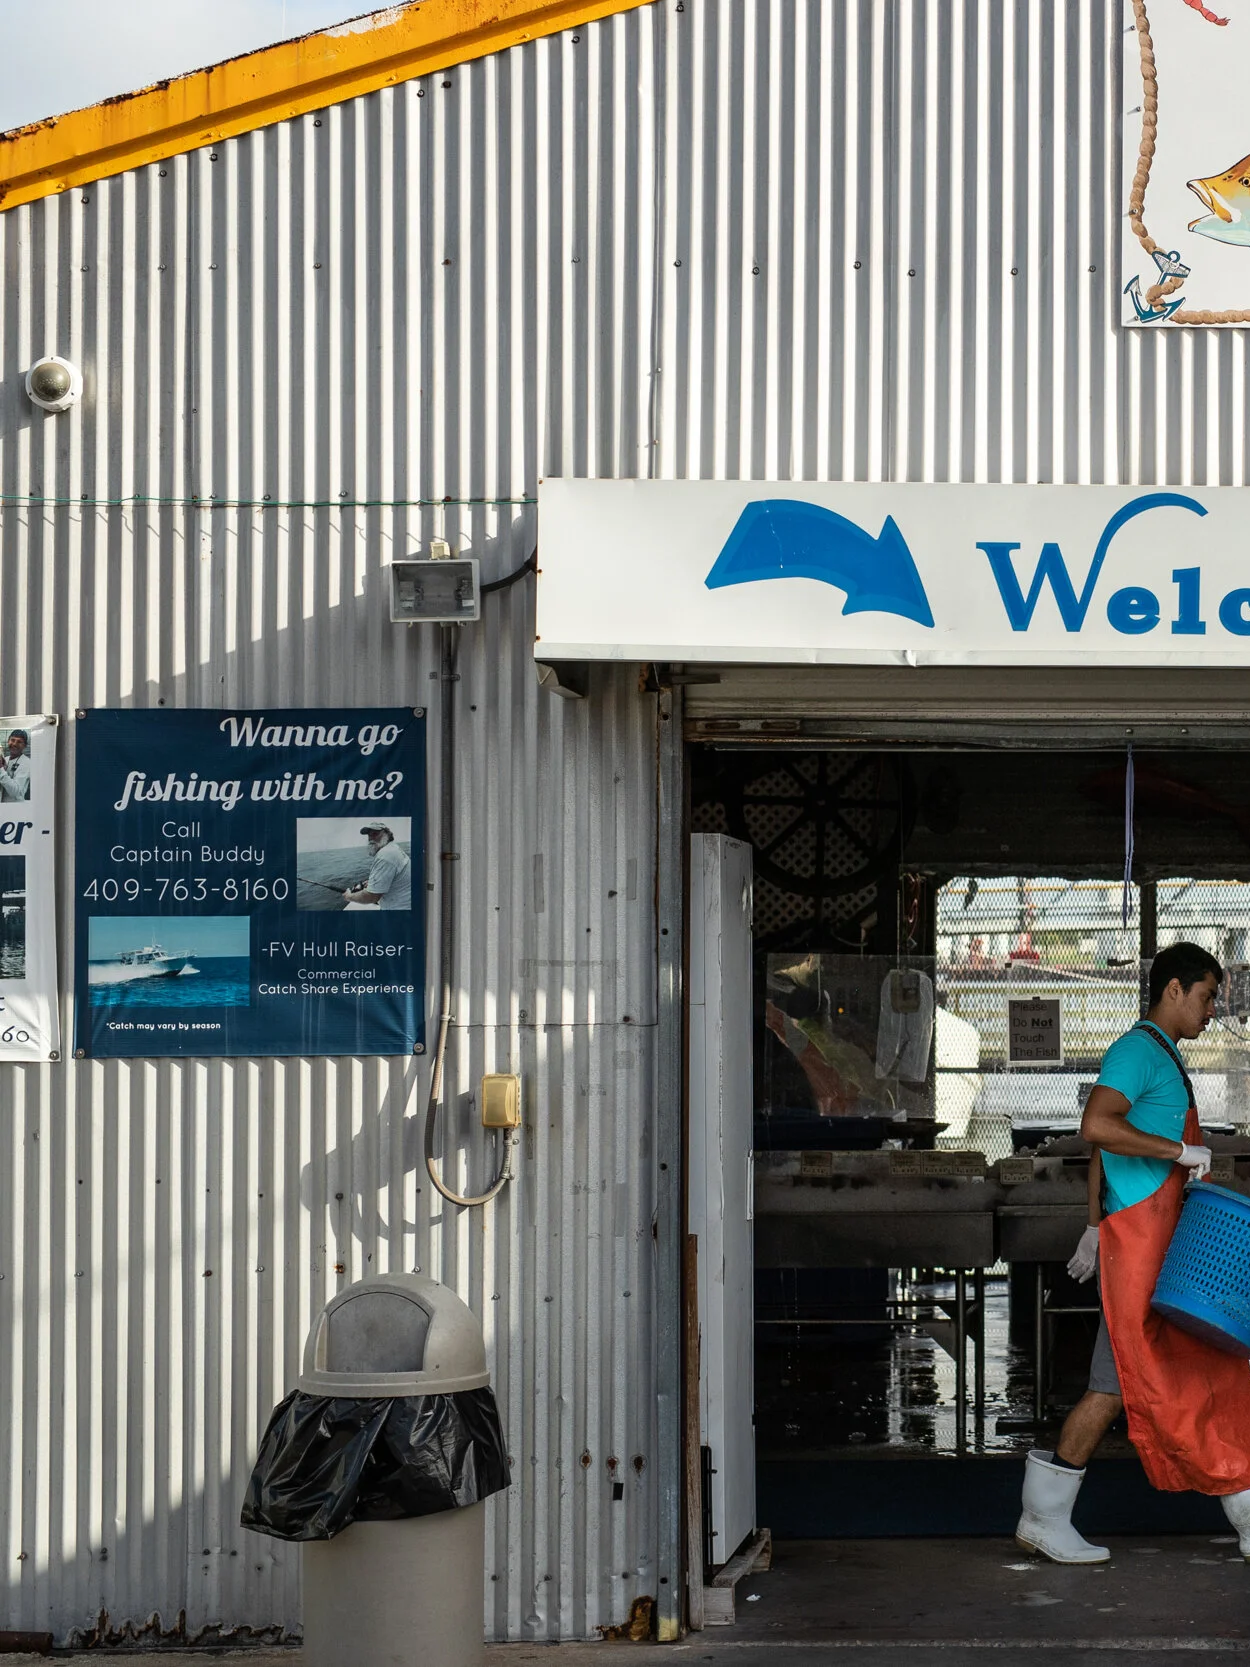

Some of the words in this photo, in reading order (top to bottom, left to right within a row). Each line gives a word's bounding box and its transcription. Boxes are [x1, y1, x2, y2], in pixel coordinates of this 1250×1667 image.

[219, 717, 353, 748] Wanna
[357, 727, 401, 756] go
[114, 770, 243, 811] fishing
[250, 772, 331, 802] with
[334, 771, 403, 801] me?
[161, 821, 201, 839] Call
[110, 846, 192, 866] Captain
[200, 846, 265, 866] Buddy
[83, 878, 289, 902] 409-763-8160
[261, 942, 295, 958] -FV
[302, 942, 338, 957] Hull
[344, 942, 413, 957] Raiser-
[297, 968, 376, 980] Commercial
[258, 983, 297, 994] Catch
[301, 983, 339, 995] Share
[342, 982, 414, 996] Experience
[1012, 1002, 1047, 1011] Please
[136, 1022, 155, 1031] may
[157, 1022, 176, 1031] vary
[178, 1021, 189, 1031] by
[191, 1021, 221, 1031] season
[1013, 1018, 1027, 1027] Do
[1031, 1018, 1053, 1028] Not
[1012, 1033, 1044, 1042] Touch
[1013, 1047, 1033, 1057] The
[1036, 1047, 1057, 1057] Fish
